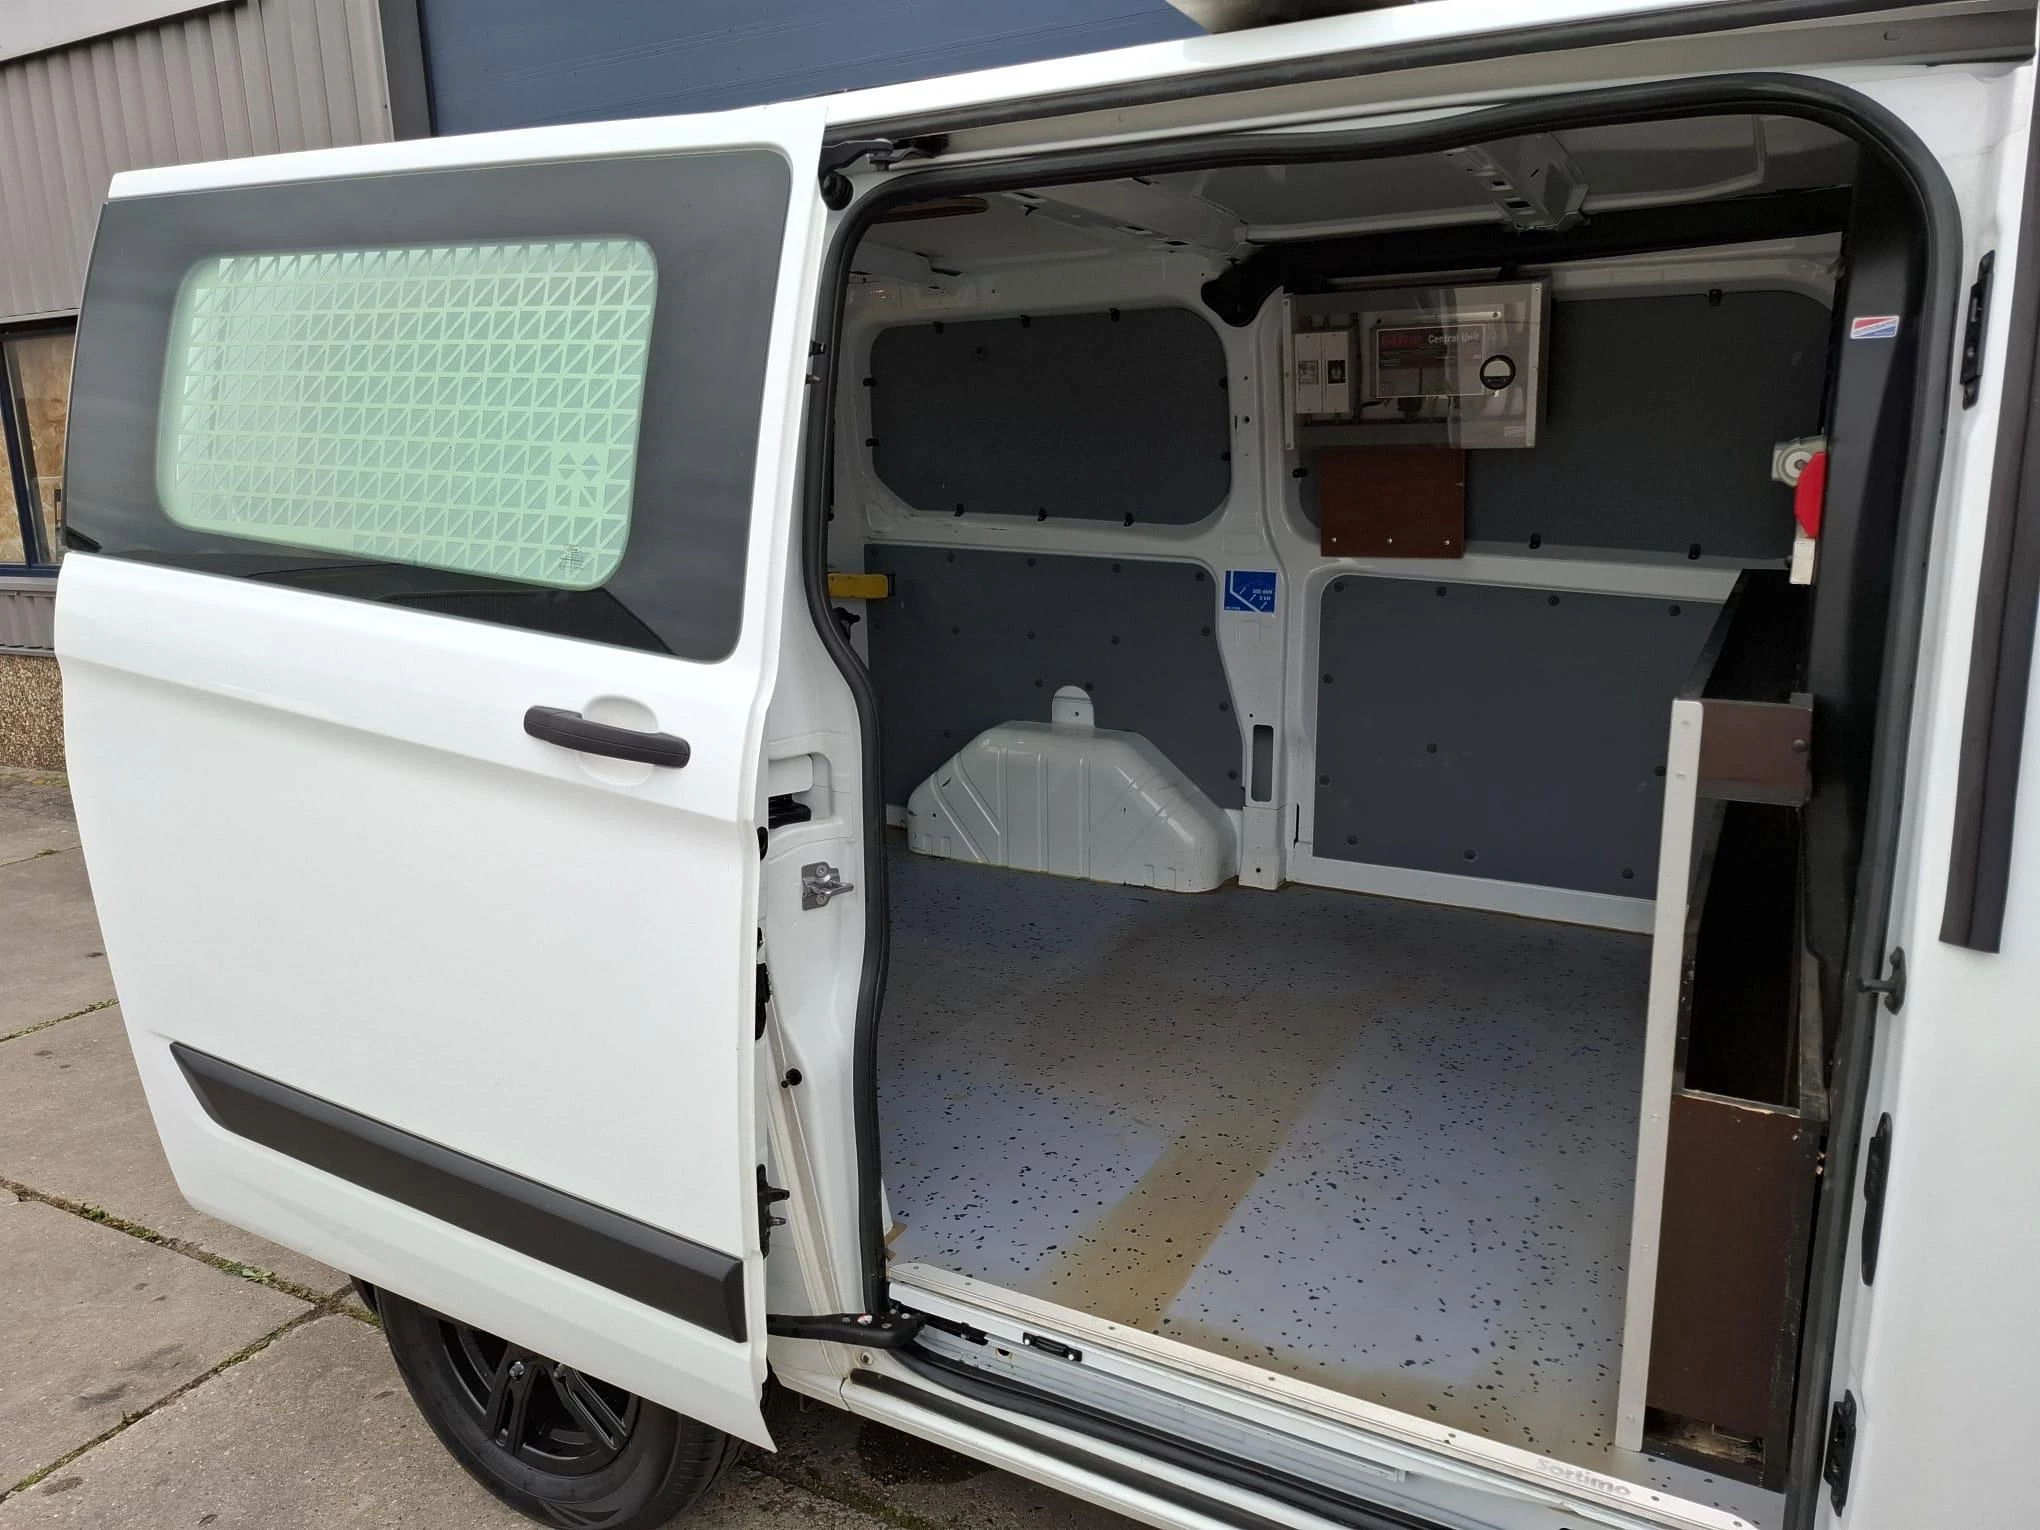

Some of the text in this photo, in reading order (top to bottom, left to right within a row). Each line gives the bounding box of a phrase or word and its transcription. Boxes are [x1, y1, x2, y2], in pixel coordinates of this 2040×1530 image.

[1428, 333, 1458, 345] Central
[1462, 332, 1479, 343] Unit
[1535, 1458, 1631, 1496] Sortimo
